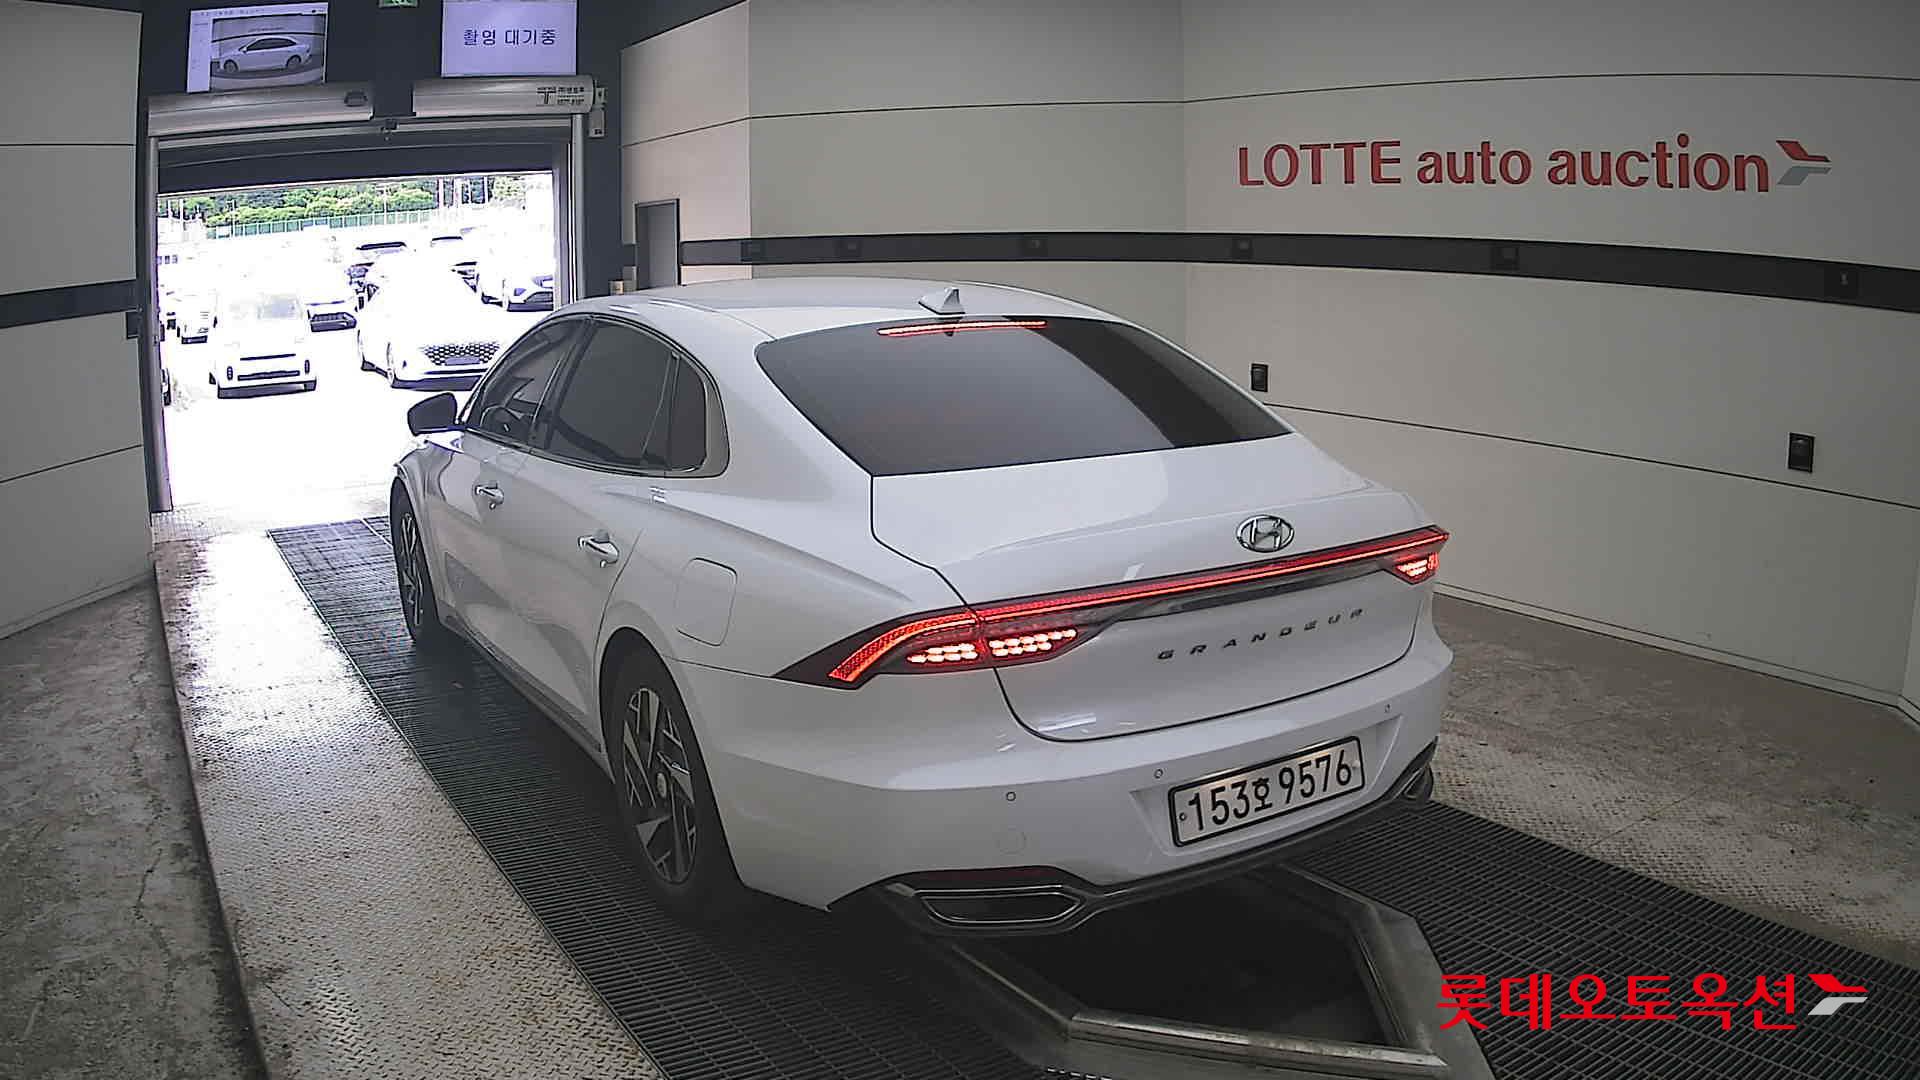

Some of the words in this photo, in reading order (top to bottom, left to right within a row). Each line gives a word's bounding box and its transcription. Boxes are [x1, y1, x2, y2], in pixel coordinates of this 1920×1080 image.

[504, 28, 556, 46] 대기중
[1239, 140, 1402, 188] LOTTE
[1416, 142, 1532, 185] auto
[1548, 134, 1770, 193] auction
[1157, 608, 1363, 660] GRANDEUR
